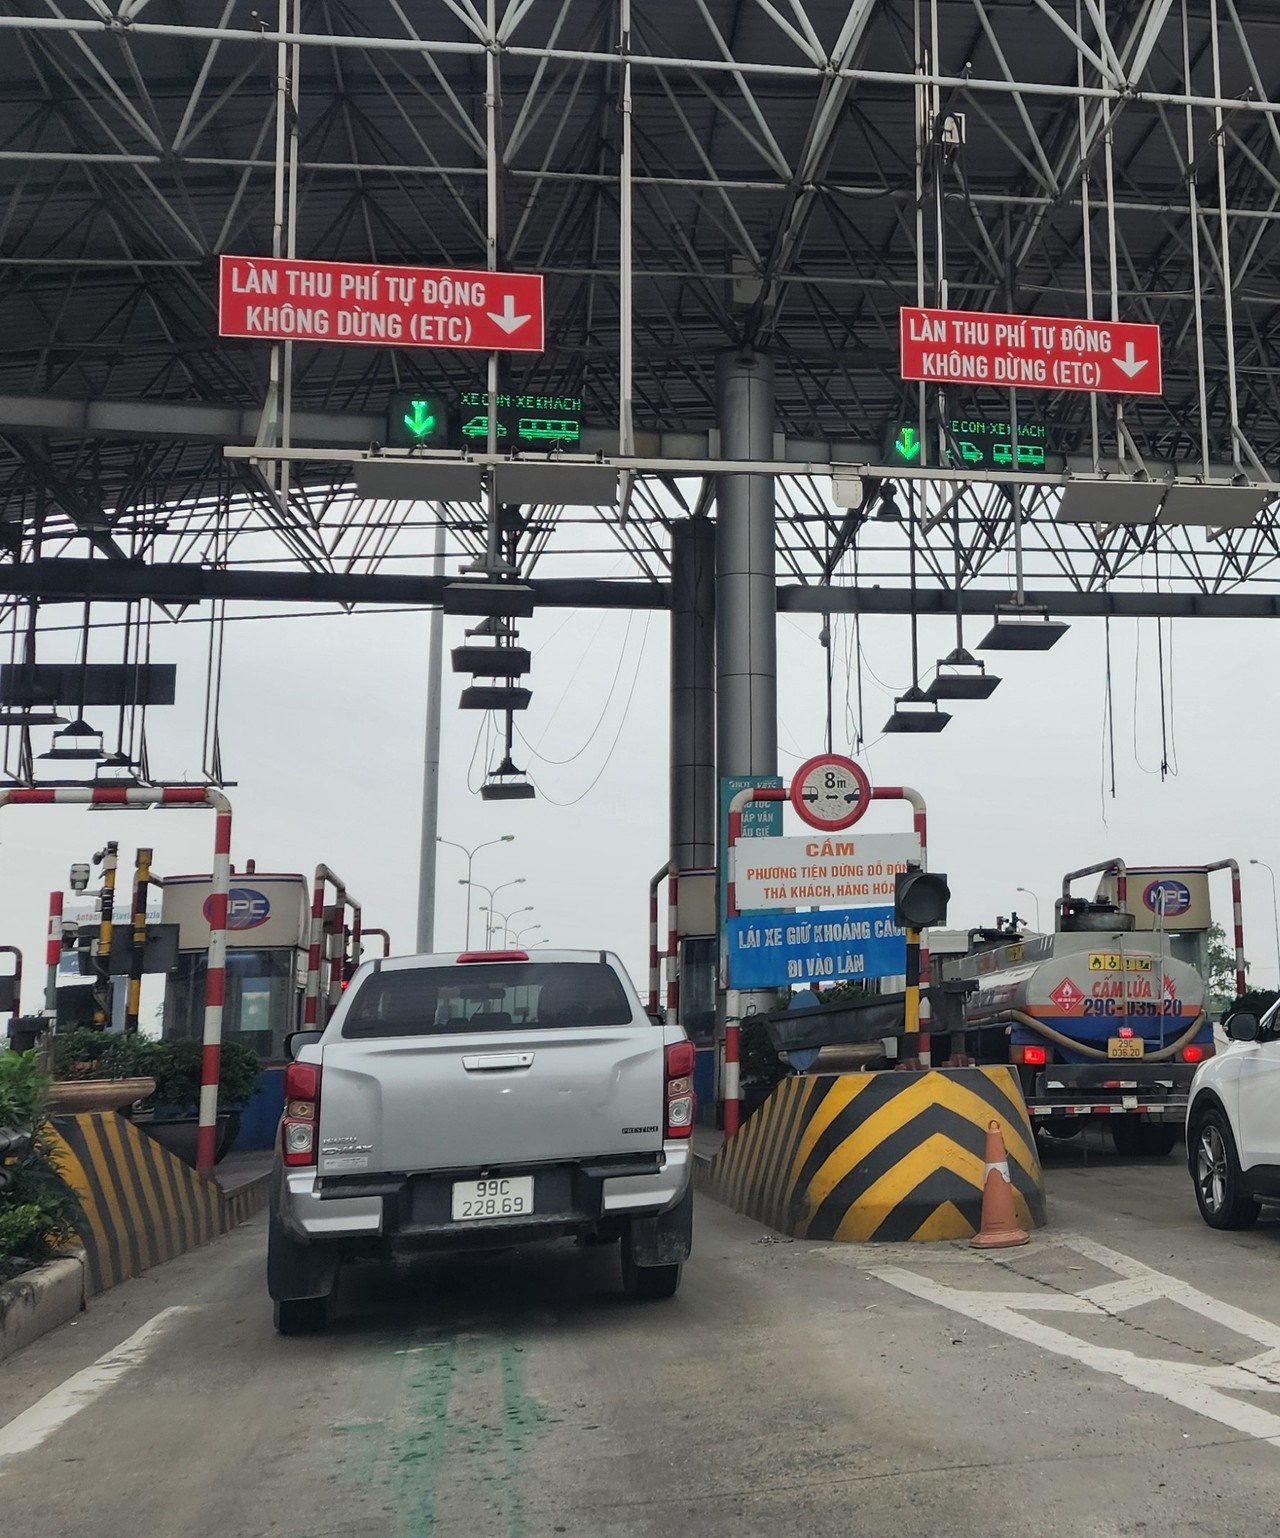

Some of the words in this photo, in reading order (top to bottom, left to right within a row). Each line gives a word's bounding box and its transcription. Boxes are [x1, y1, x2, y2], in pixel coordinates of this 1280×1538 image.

[232, 262, 277, 294] LÀN
[286, 270, 332, 298] THU
[341, 271, 380, 300] PHÍ
[386, 276, 415, 307] TỰ
[422, 276, 485, 308] ĐỘNG
[246, 304, 329, 334] KHÔNG
[338, 306, 402, 339] DỪNG
[410, 314, 471, 343] (ETC)
[910, 314, 946, 342] LÀN
[952, 321, 990, 345] THU
[996, 320, 1027, 347] PHÍ
[1031, 326, 1055, 354] TỰ
[1060, 326, 1111, 356] ĐỘNG
[923, 350, 988, 378] KHÔNG
[995, 352, 1046, 381] DỪNG
[1053, 360, 1100, 386] (ETC)
[461, 393, 479, 405] XE
[806, 839, 854, 856] CẤM
[747, 866, 797, 880] PHƯƠNG
[801, 864, 830, 880] TIỆN
[832, 863, 863, 877] DỪNG
[764, 884, 786, 899] THẢ
[790, 884, 834, 898] KHÁCH,
[837, 883, 868, 896] HÀNG
[227, 900, 265, 914] PC
[739, 926, 760, 948] LÁI
[764, 929, 782, 946] XE
[787, 922, 811, 945] GIỮ
[814, 916, 870, 942] KHOẢNG
[788, 960, 802, 978] ĐI
[806, 953, 833, 976] VÀO
[838, 951, 864, 973] LÀN
[1092, 975, 1122, 997] CẤM
[1128, 975, 1151, 998] LỬA
[477, 1180, 509, 1197] 99C
[462, 1197, 523, 1216] 228.69
